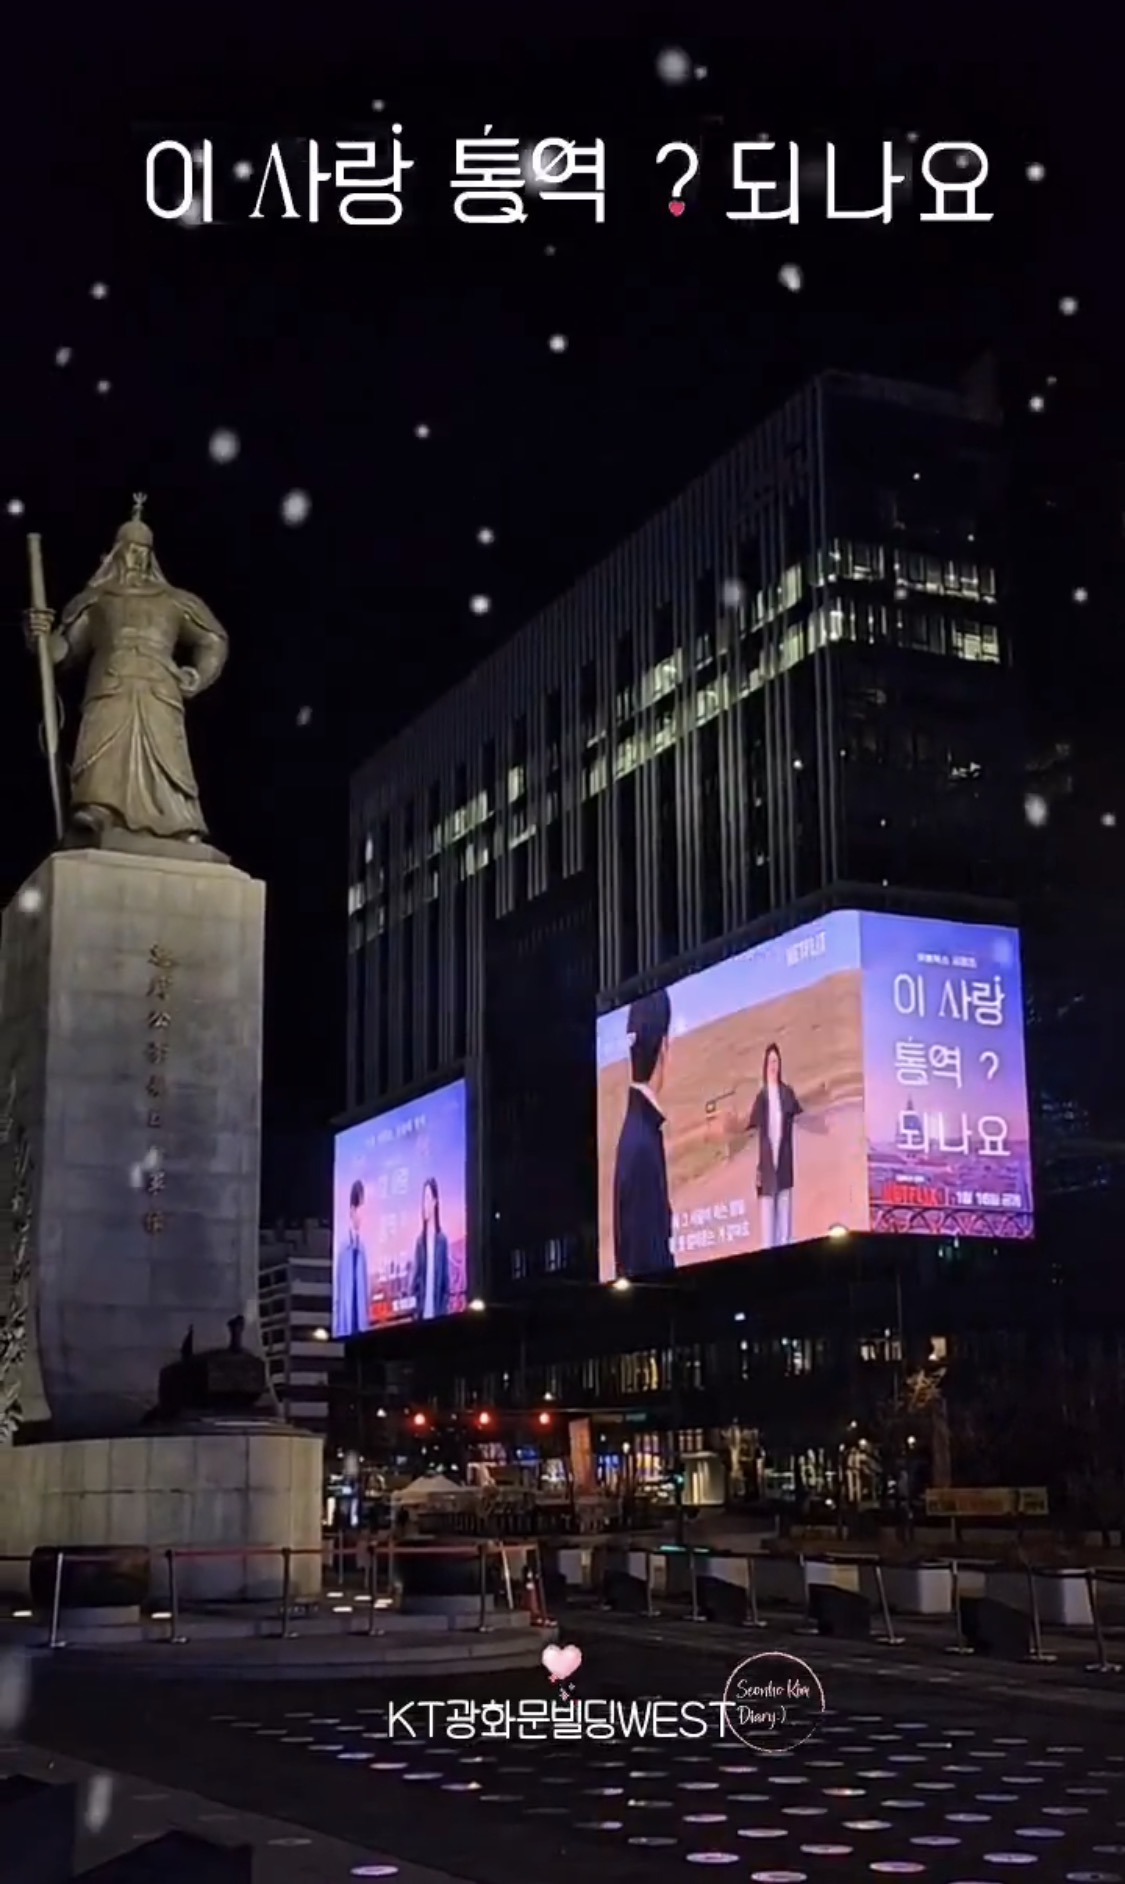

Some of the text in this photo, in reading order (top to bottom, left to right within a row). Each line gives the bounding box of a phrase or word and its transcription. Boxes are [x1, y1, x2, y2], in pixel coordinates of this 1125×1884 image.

[893, 973, 1006, 1026] 이 사랑
[894, 1036, 1000, 1089] 통역 ?
[897, 1110, 1012, 1157] 되나요
